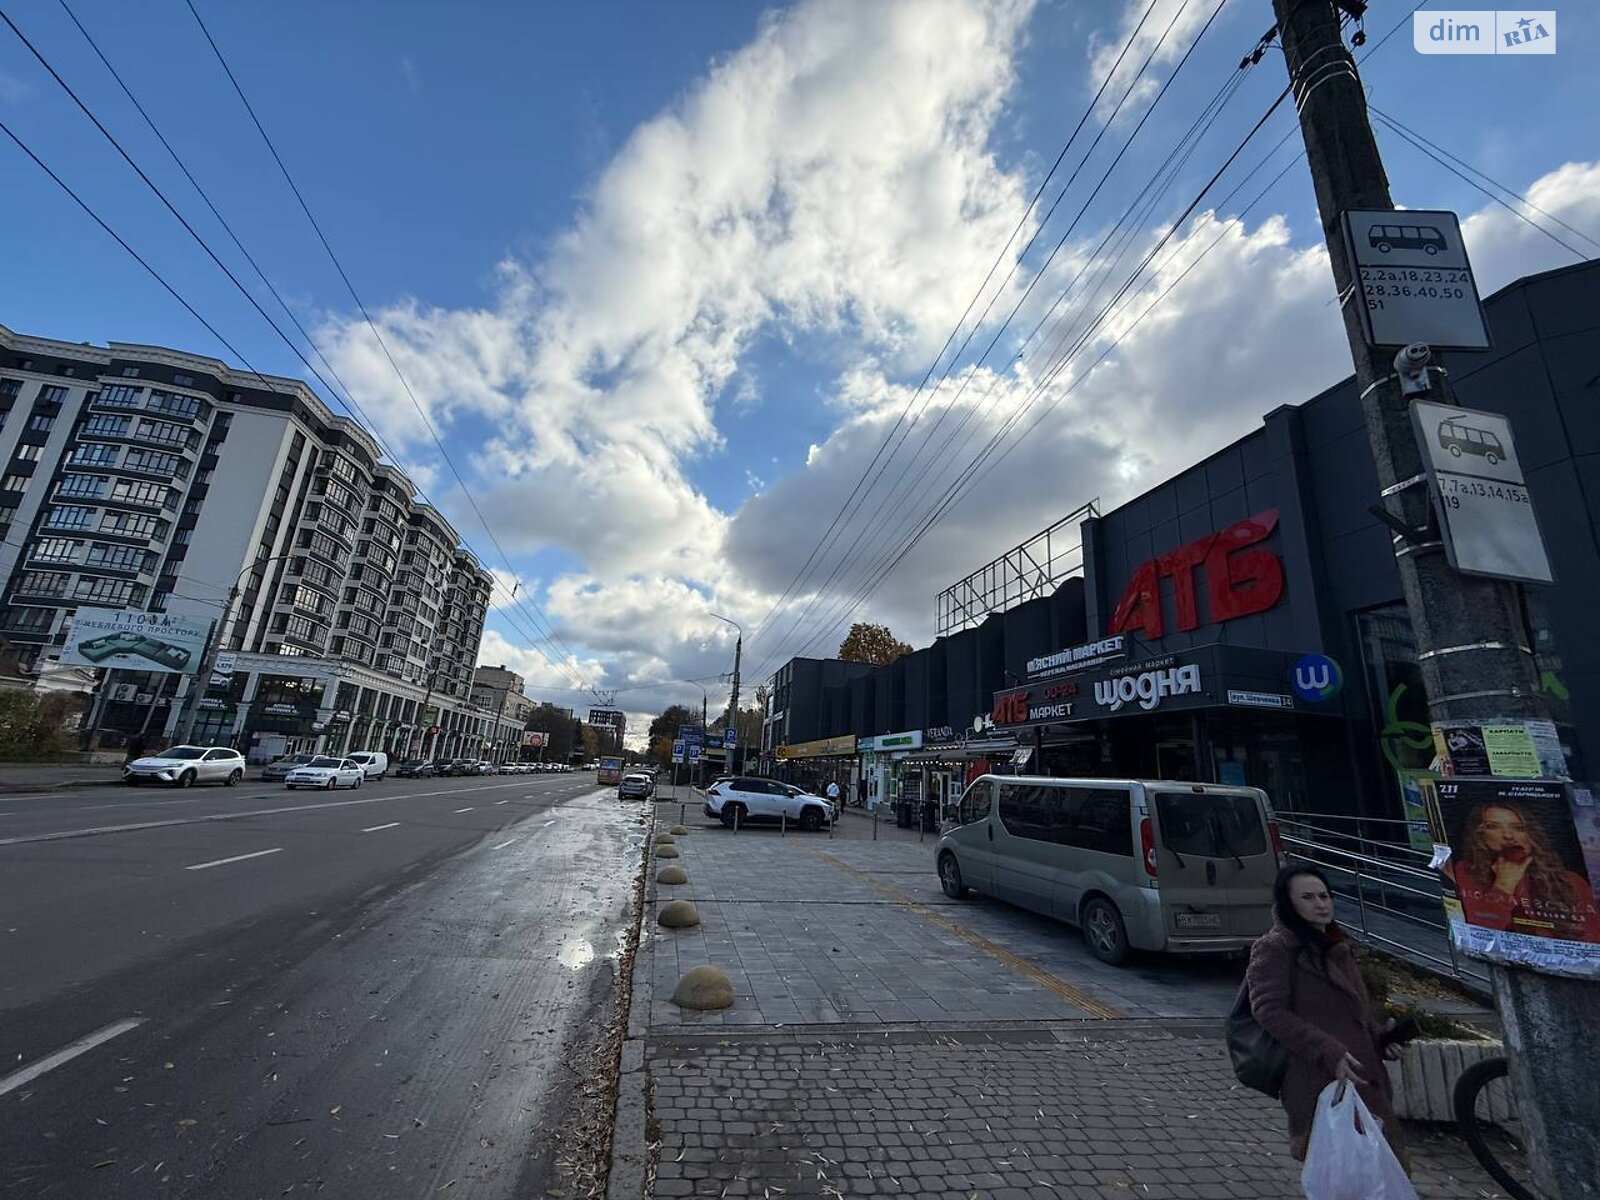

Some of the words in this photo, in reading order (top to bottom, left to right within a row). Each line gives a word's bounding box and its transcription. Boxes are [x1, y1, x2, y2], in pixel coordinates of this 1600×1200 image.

[1368, 299, 1385, 310] 51
[1445, 495, 1460, 509] 19
[1108, 507, 1284, 641] АТБ
[1072, 635, 1125, 661] МАРКЕТ
[992, 691, 1029, 724] АТБ
[1029, 703, 1073, 720] МАРКЕТ
